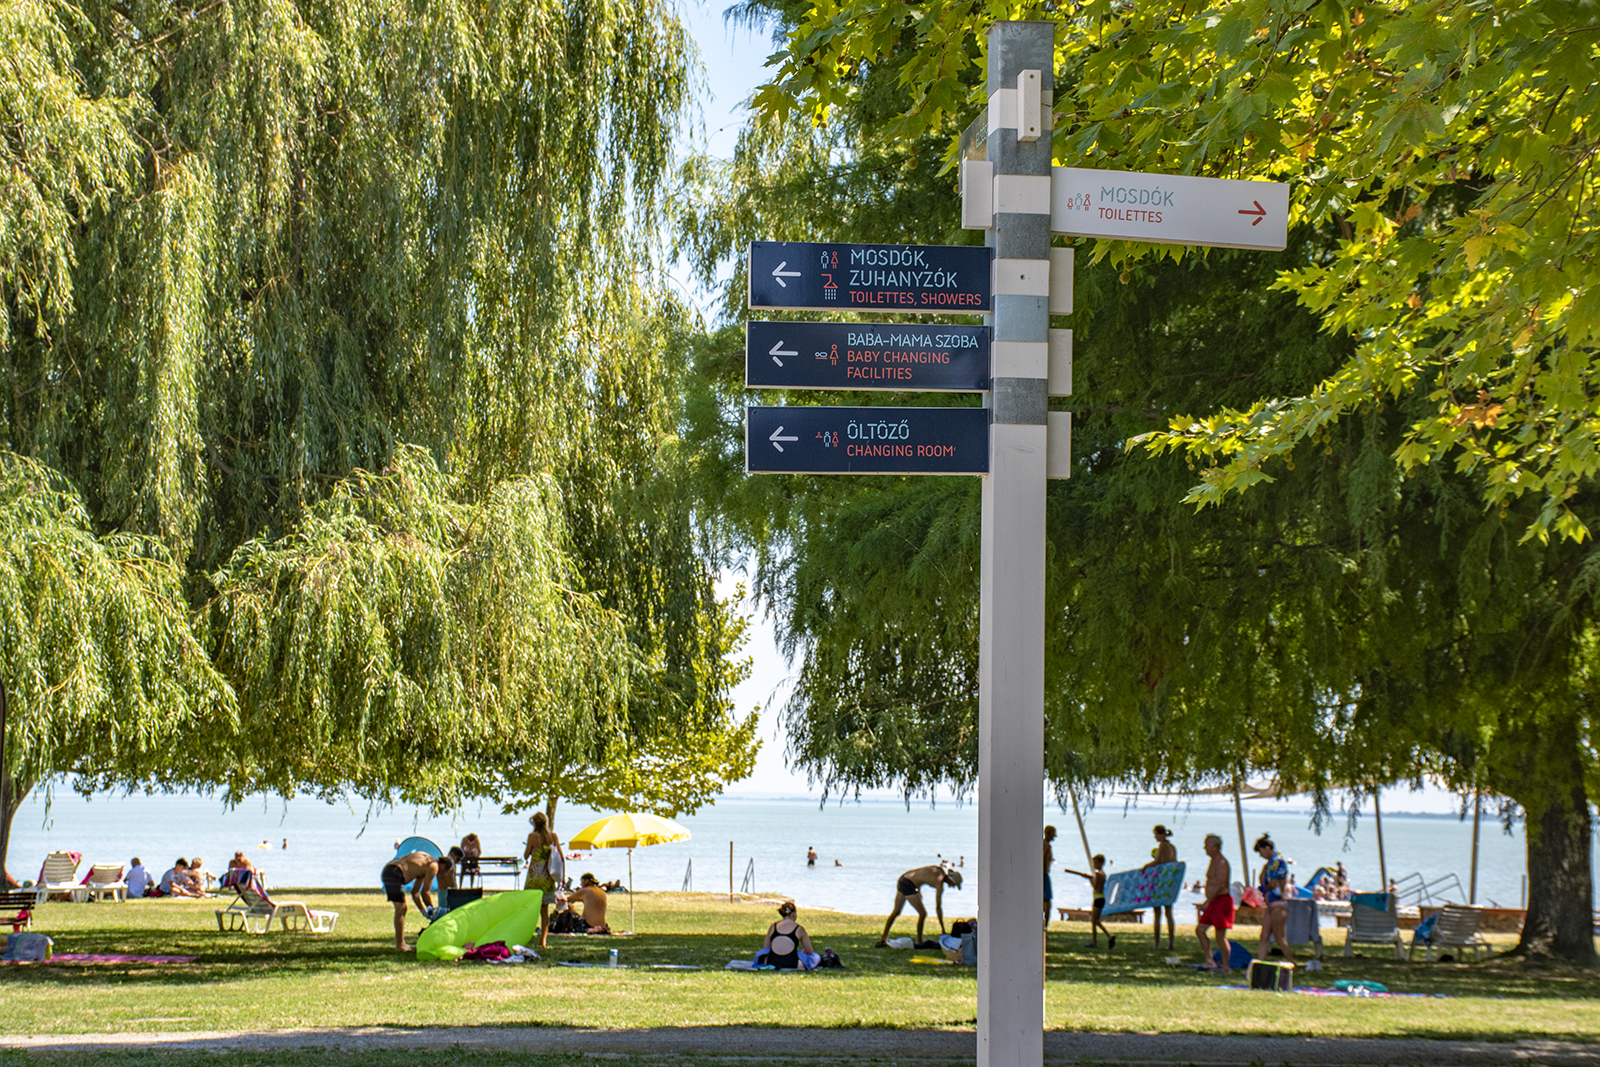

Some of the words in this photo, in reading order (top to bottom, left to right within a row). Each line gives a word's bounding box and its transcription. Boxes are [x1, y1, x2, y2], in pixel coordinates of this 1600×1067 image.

[1100, 186, 1174, 207] MOSDÓK
[1098, 207, 1163, 224] TOILETTES
[850, 246, 929, 269] MOSDÓK,
[849, 267, 958, 288] ZUHANYZÓK
[849, 291, 918, 306] TOILETTES,
[920, 292, 982, 306] SHOWERS
[847, 333, 933, 348] BABA-MAMA
[935, 334, 979, 348] SZOBA
[847, 351, 881, 363] BABY
[883, 351, 950, 364] CHANGING
[847, 367, 913, 380] FACILITIES
[847, 419, 910, 440] ÖLTÖZŐ
[847, 445, 913, 457] CHANGING
[917, 445, 954, 457] ROOM
